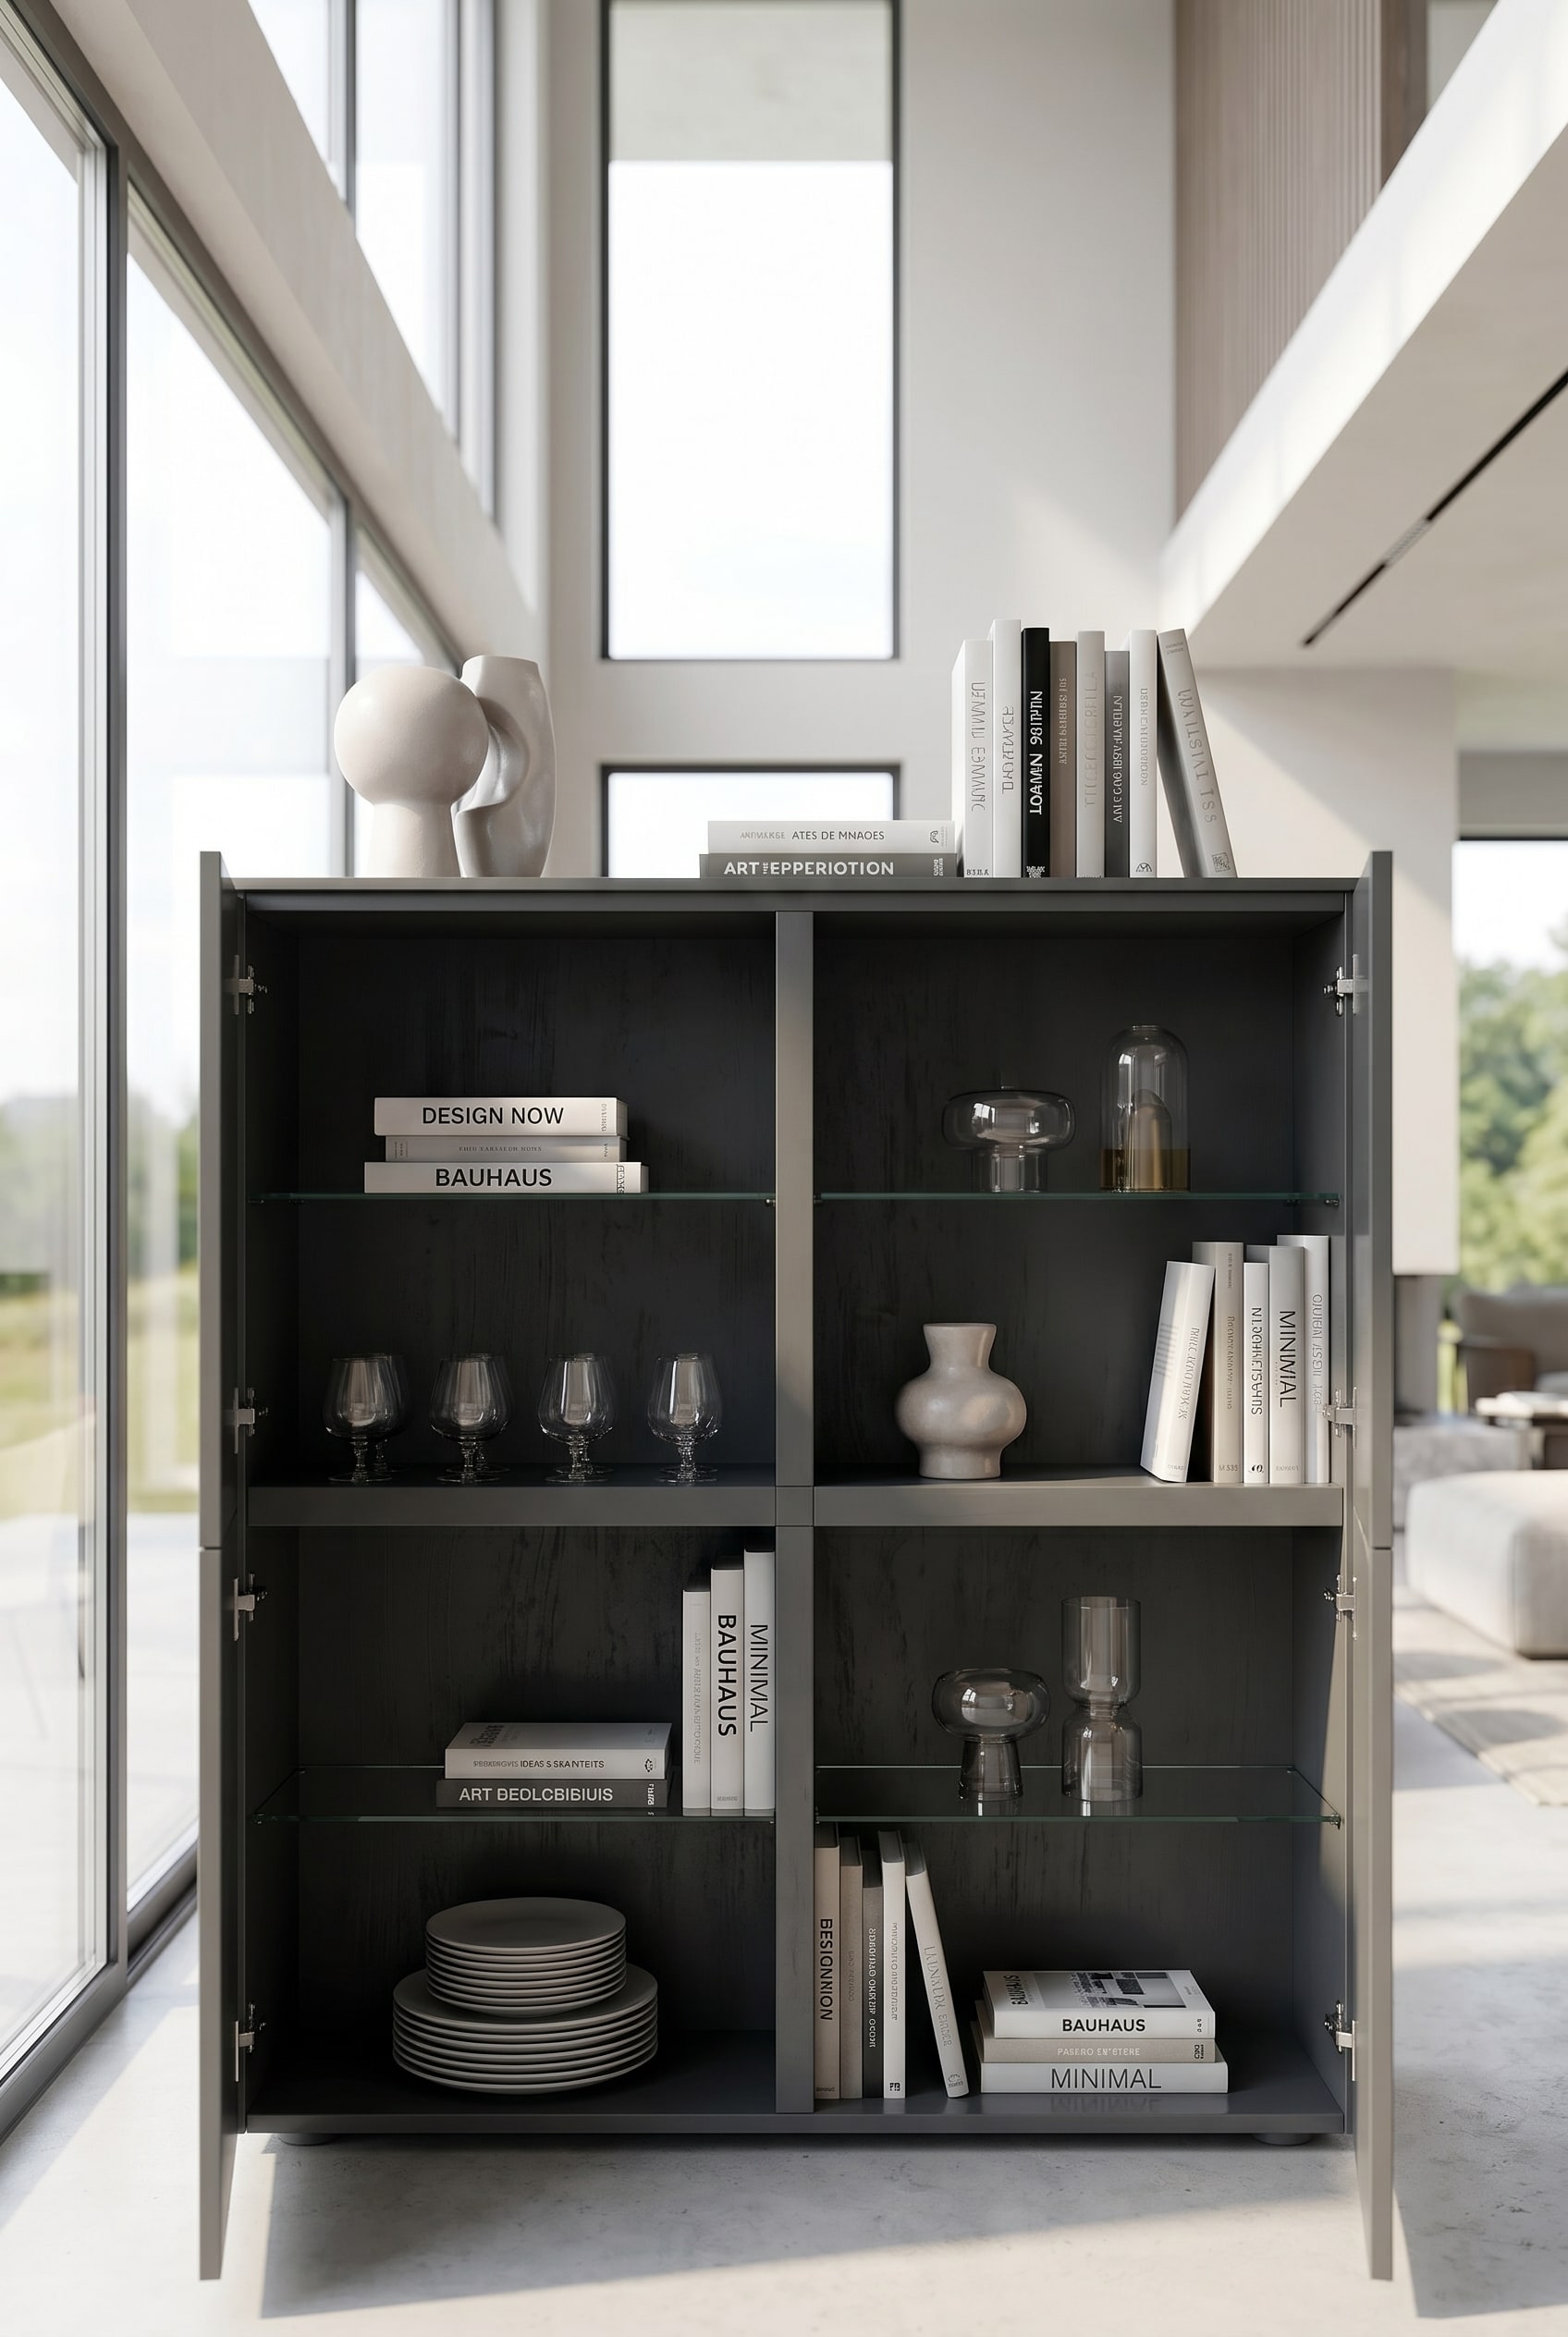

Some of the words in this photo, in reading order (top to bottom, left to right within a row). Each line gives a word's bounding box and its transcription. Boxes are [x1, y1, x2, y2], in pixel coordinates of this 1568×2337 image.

[821, 830, 835, 840] DE
[723, 861, 760, 875] ART
[770, 861, 894, 875] EPPERIOTION
[423, 1106, 505, 1125] DESIGN
[511, 1107, 564, 1125] NOW
[435, 1168, 552, 1188] BAUHAUS
[717, 1614, 738, 1737] BAUHAUS
[750, 1624, 769, 1732] MINIMAL
[520, 1760, 545, 1768] IDEAS
[459, 1787, 493, 1801] ART
[1062, 2018, 1145, 2032] BAUHAUS
[1051, 2068, 1162, 2089] MINIMAL
